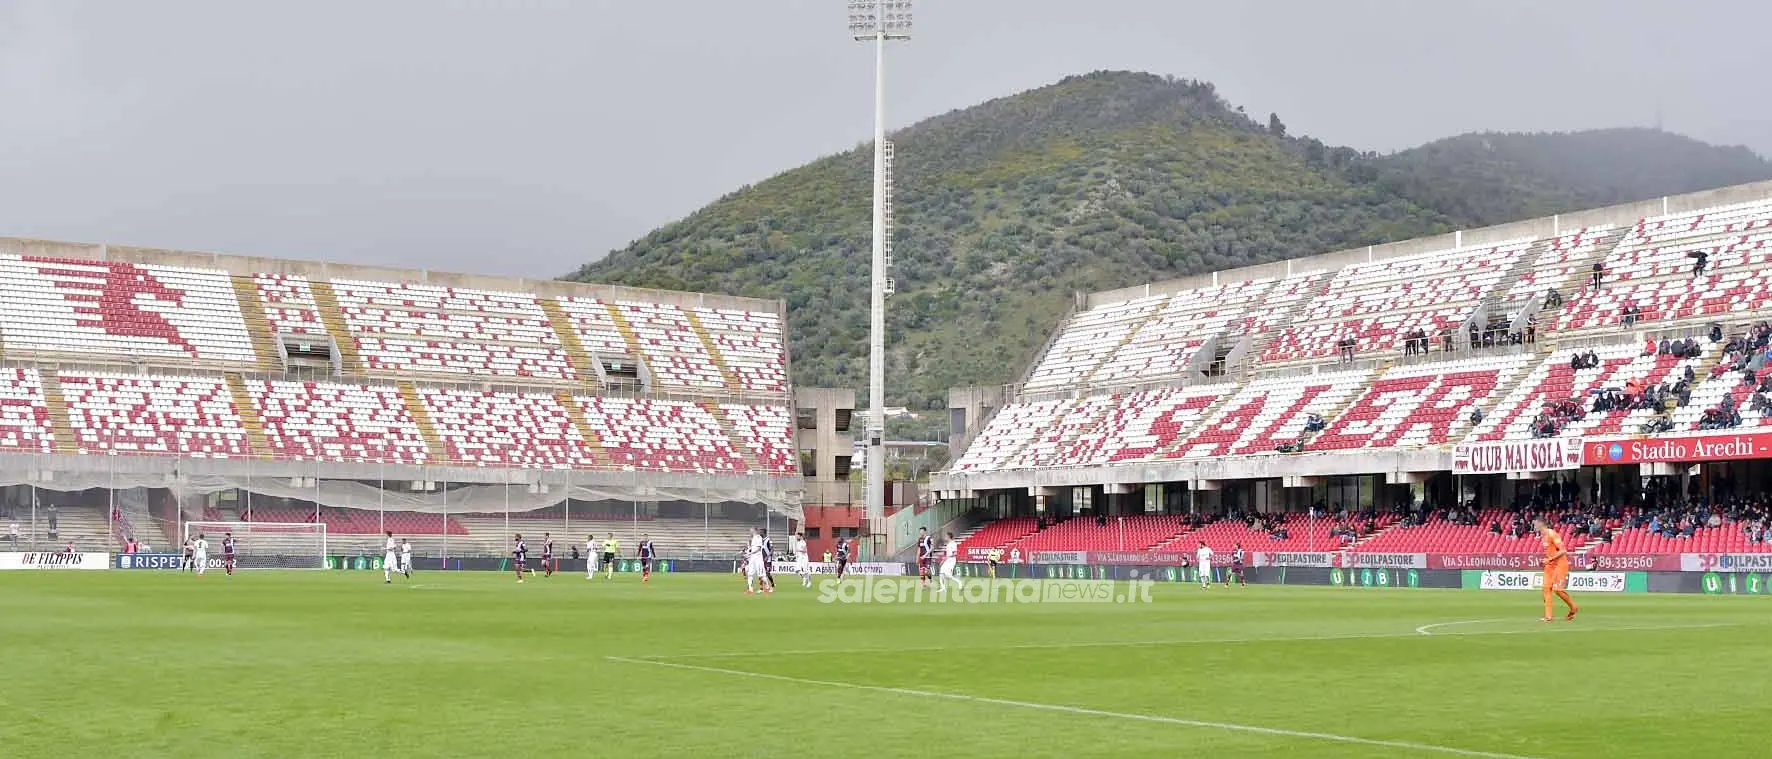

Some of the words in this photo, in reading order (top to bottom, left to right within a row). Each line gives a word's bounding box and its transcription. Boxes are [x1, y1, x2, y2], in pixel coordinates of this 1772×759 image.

[1631, 441, 1685, 460] Stadio
[1692, 437, 1753, 458] Arechi
[1471, 445, 1502, 472] CLUB
[1505, 443, 1528, 470] MAI
[1531, 440, 1564, 469] SOLA
[22, 552, 36, 565] DE
[1277, 553, 1327, 564] EDILPASTORE
[1360, 554, 1415, 565] EDILPASTORE
[1509, 556, 1521, 568] 45
[1598, 555, 1653, 569] 89.332560
[1497, 573, 1529, 587] Serie
[1572, 577, 1608, 587] 2018-19
